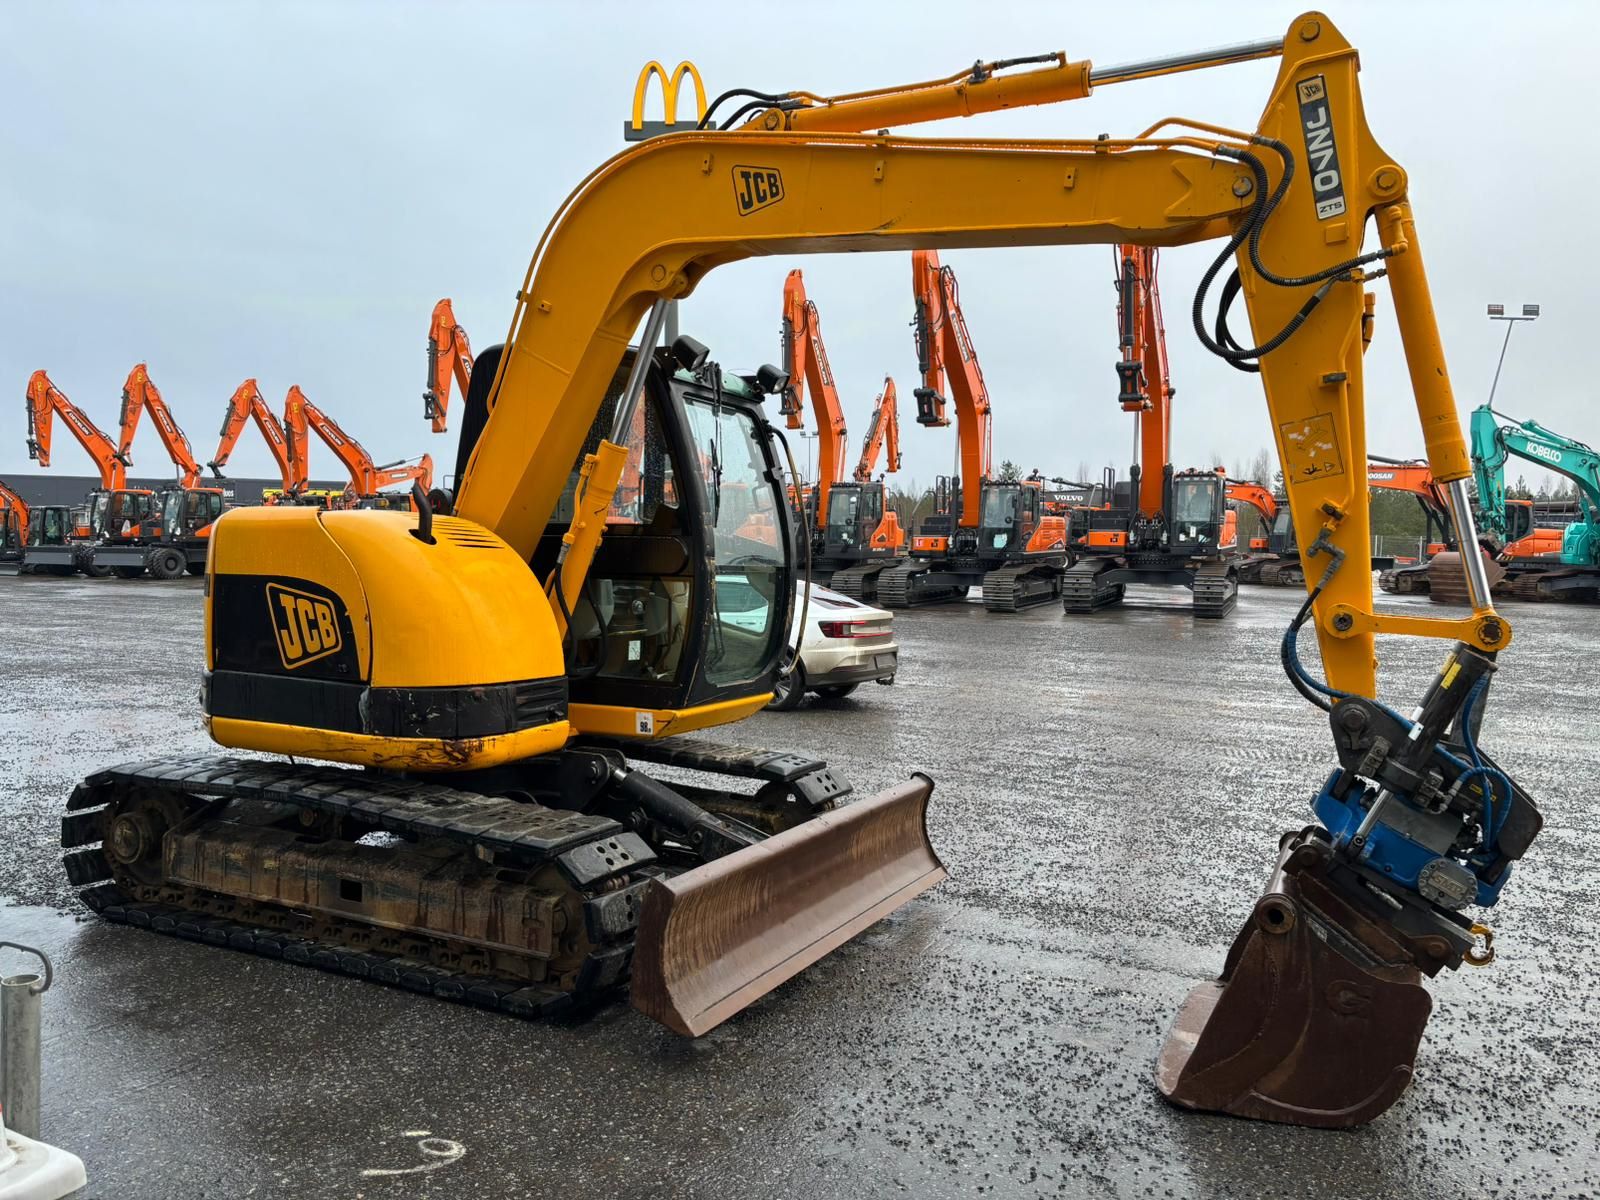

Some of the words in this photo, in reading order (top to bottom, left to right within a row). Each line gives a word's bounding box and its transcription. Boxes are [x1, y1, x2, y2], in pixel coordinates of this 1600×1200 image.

[740, 170, 780, 210] JCB
[1319, 201, 1343, 213] ZTS
[1526, 441, 1562, 463] KOBELCO
[1368, 472, 1393, 480] OOSAN
[1054, 494, 1084, 502] VOLVO
[279, 593, 338, 660] JCB
